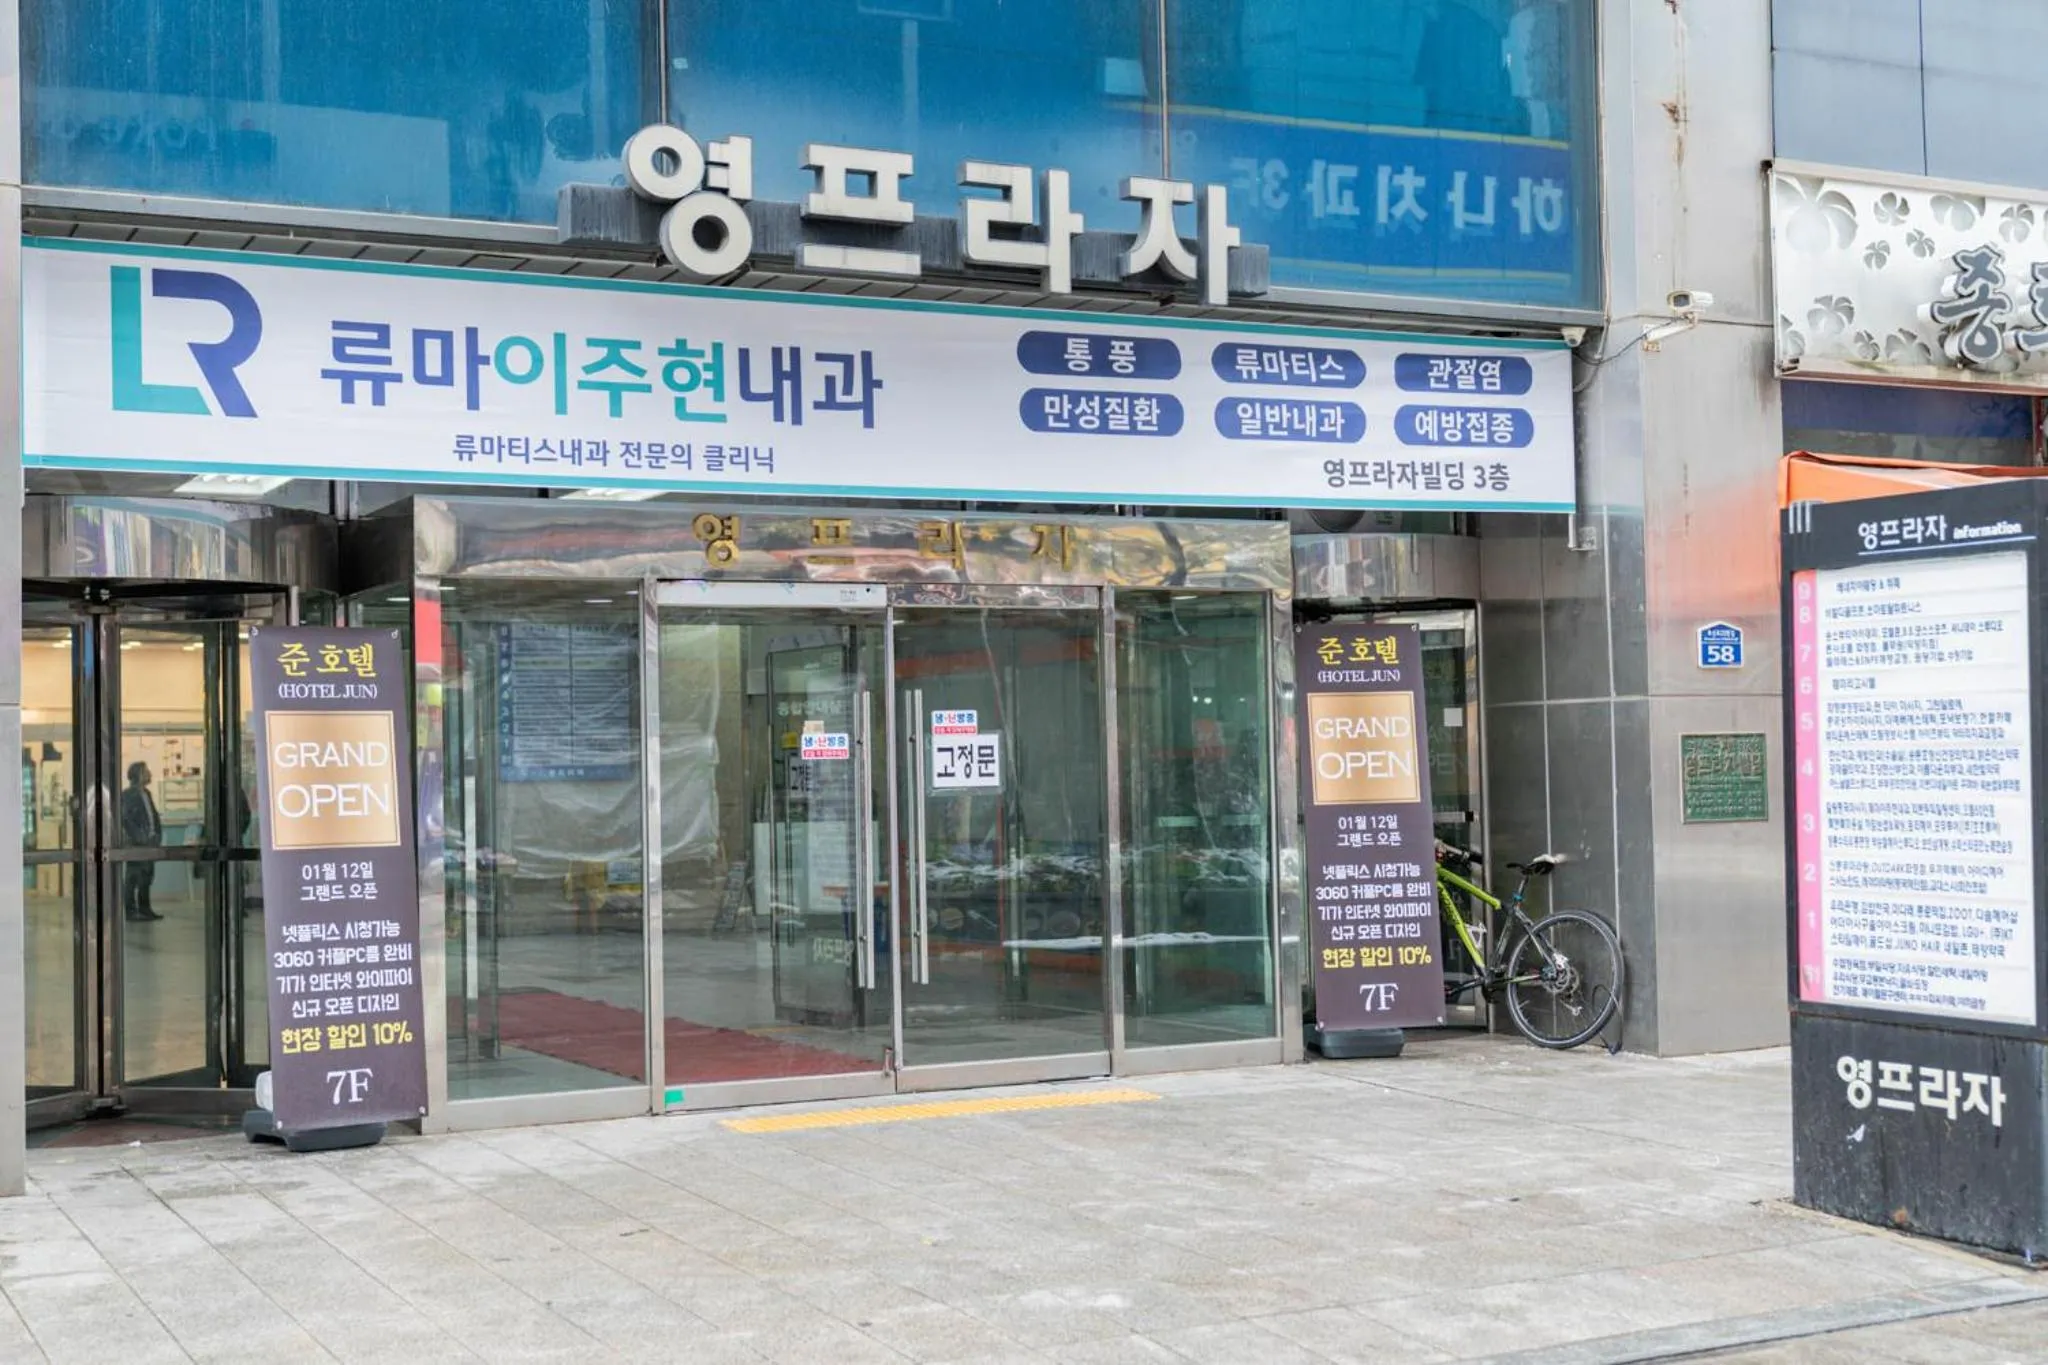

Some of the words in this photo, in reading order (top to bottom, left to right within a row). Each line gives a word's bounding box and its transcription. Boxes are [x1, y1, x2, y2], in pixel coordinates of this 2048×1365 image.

[622, 121, 1241, 307] 영프라자
[320, 319, 884, 430] 류마이주현내과
[1234, 347, 1347, 383] 류마티스
[1427, 357, 1502, 392] 관절염
[1043, 392, 1162, 432] 만성질환
[1235, 401, 1346, 439] 일반내과
[1414, 407, 1515, 444] 예방접종
[453, 433, 612, 470] 류마티스내과
[619, 439, 694, 471] 전문의
[702, 444, 776, 475] 클리닉
[1322, 456, 1466, 492] 영프라자빌딩
[1474, 463, 1512, 493] 3층
[691, 512, 1079, 573] 영프라자
[1858, 514, 1948, 550] 영프라자
[277, 643, 311, 677] 준
[316, 643, 376, 677] 호텔
[1317, 637, 1344, 665] 준
[1348, 635, 1400, 665] 호텔
[1707, 645, 1735, 663] 58
[278, 683, 341, 699] (HOTEL
[343, 683, 378, 699] JUN)
[1317, 669, 1370, 683] (HOTEL
[1371, 669, 1401, 682] JUN)
[1315, 715, 1411, 740] GRAND
[274, 741, 389, 768] GRAND
[936, 743, 996, 779] 고정문
[1317, 750, 1412, 780] OPEN
[277, 783, 391, 818] OPEN
[1338, 816, 1367, 830] 01월
[1371, 815, 1398, 829] 12일
[1337, 833, 1375, 848] 그랜드
[1377, 831, 1402, 847] 오픈
[302, 862, 337, 881] 01월
[341, 861, 374, 879] 12일
[1322, 864, 1371, 880] 넷플릭스
[1374, 862, 1421, 878] 시청가능
[1804, 862, 1817, 882] 2
[301, 884, 345, 902] 그랜드
[348, 882, 378, 900] 오픈
[1315, 886, 1349, 900] 3060
[1406, 881, 1431, 897] 완비
[1318, 905, 1343, 921] 기가
[1345, 903, 1381, 919] 인터넷
[1383, 902, 1432, 918] 와이파이
[282, 922, 341, 943] 넷플릭스
[344, 920, 401, 939] 시청가능
[1331, 926, 1355, 941] 신규
[1357, 924, 1383, 939] 오픈
[1385, 922, 1421, 938] 디자인
[274, 951, 314, 968] 3060
[384, 943, 412, 962] 완비
[1322, 948, 1356, 969] 현장
[1359, 946, 1393, 967] 할인
[1398, 945, 1432, 965] 10%
[276, 975, 306, 994] 기가
[310, 972, 352, 992] 인터넷
[356, 968, 412, 989] 와이파이
[292, 999, 321, 1018] 신규
[325, 997, 354, 1016] 오픈
[358, 993, 400, 1014] 디자인
[1359, 982, 1399, 1012] 7F
[281, 1026, 321, 1054] 현장
[327, 1022, 367, 1050] 할인
[373, 1020, 413, 1045] 10%
[326, 1067, 373, 1106] 7F
[1836, 1055, 2008, 1127] 영프라자
